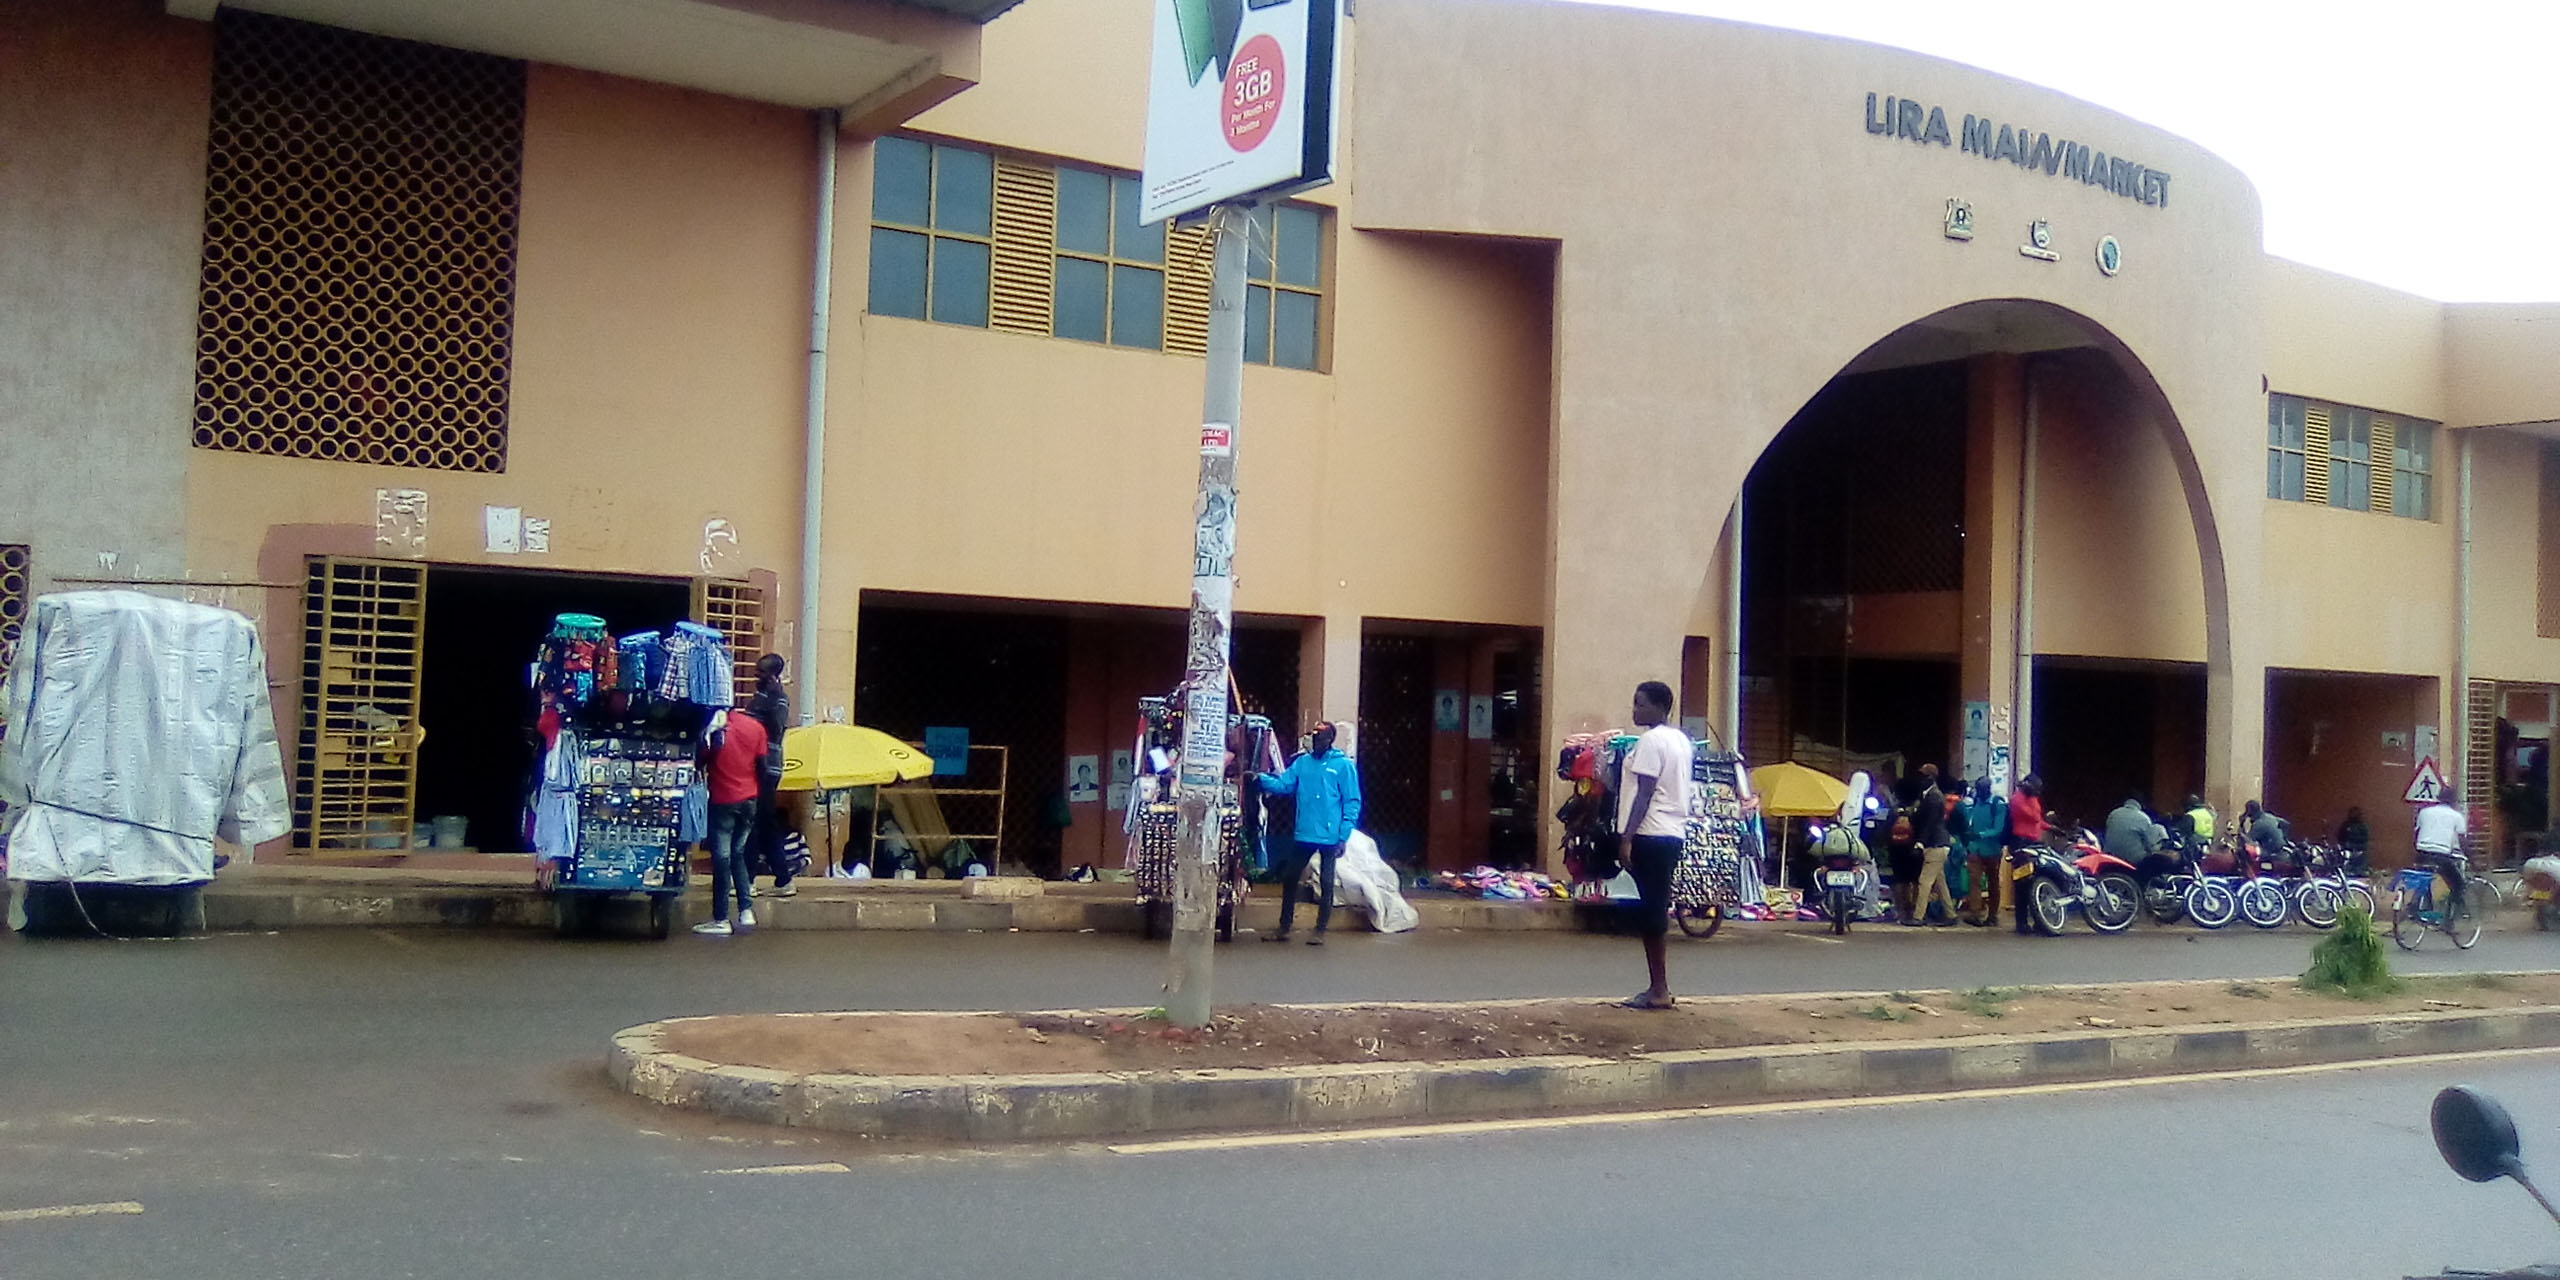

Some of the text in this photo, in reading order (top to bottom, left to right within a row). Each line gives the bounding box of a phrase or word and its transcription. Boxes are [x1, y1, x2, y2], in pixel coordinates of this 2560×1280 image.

[1235, 57, 1259, 79] FREE
[1233, 69, 1273, 107] 3GB
[1242, 104, 1264, 119] Month
[1236, 119, 1261, 135] Months
[1866, 91, 1952, 147] LIRA
[2064, 141, 2172, 209] MARKET
